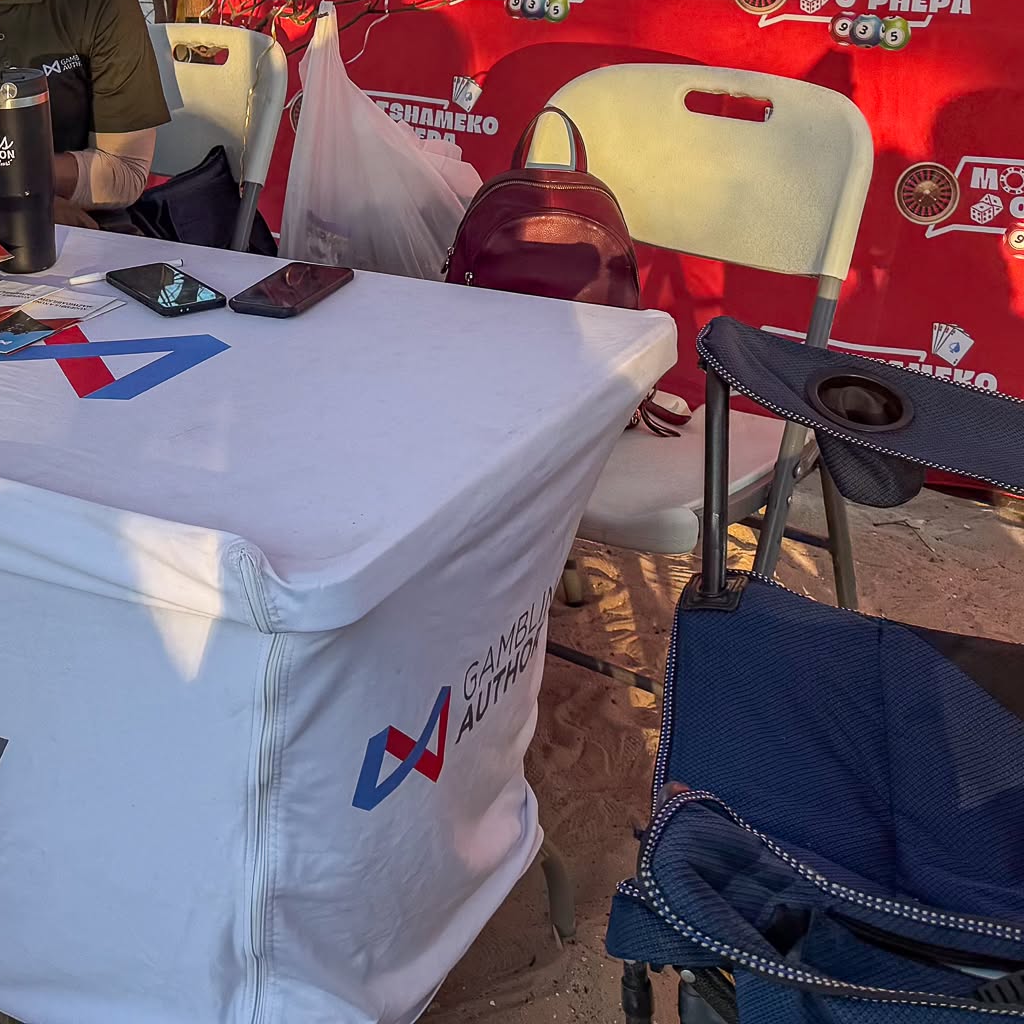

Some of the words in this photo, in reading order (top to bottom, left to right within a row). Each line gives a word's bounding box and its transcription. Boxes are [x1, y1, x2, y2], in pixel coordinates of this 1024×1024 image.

[528, 0, 536, 9] 3
[552, 5, 560, 15] 5
[838, 22, 849, 32] 9
[858, 25, 868, 35] 3
[890, 31, 898, 42] 5
[63, 60, 82, 72] AUTH
[375, 100, 499, 136] TSHAMEKO
[463, 586, 553, 701] GAMBLIN
[454, 622, 544, 745] AUTHOR
